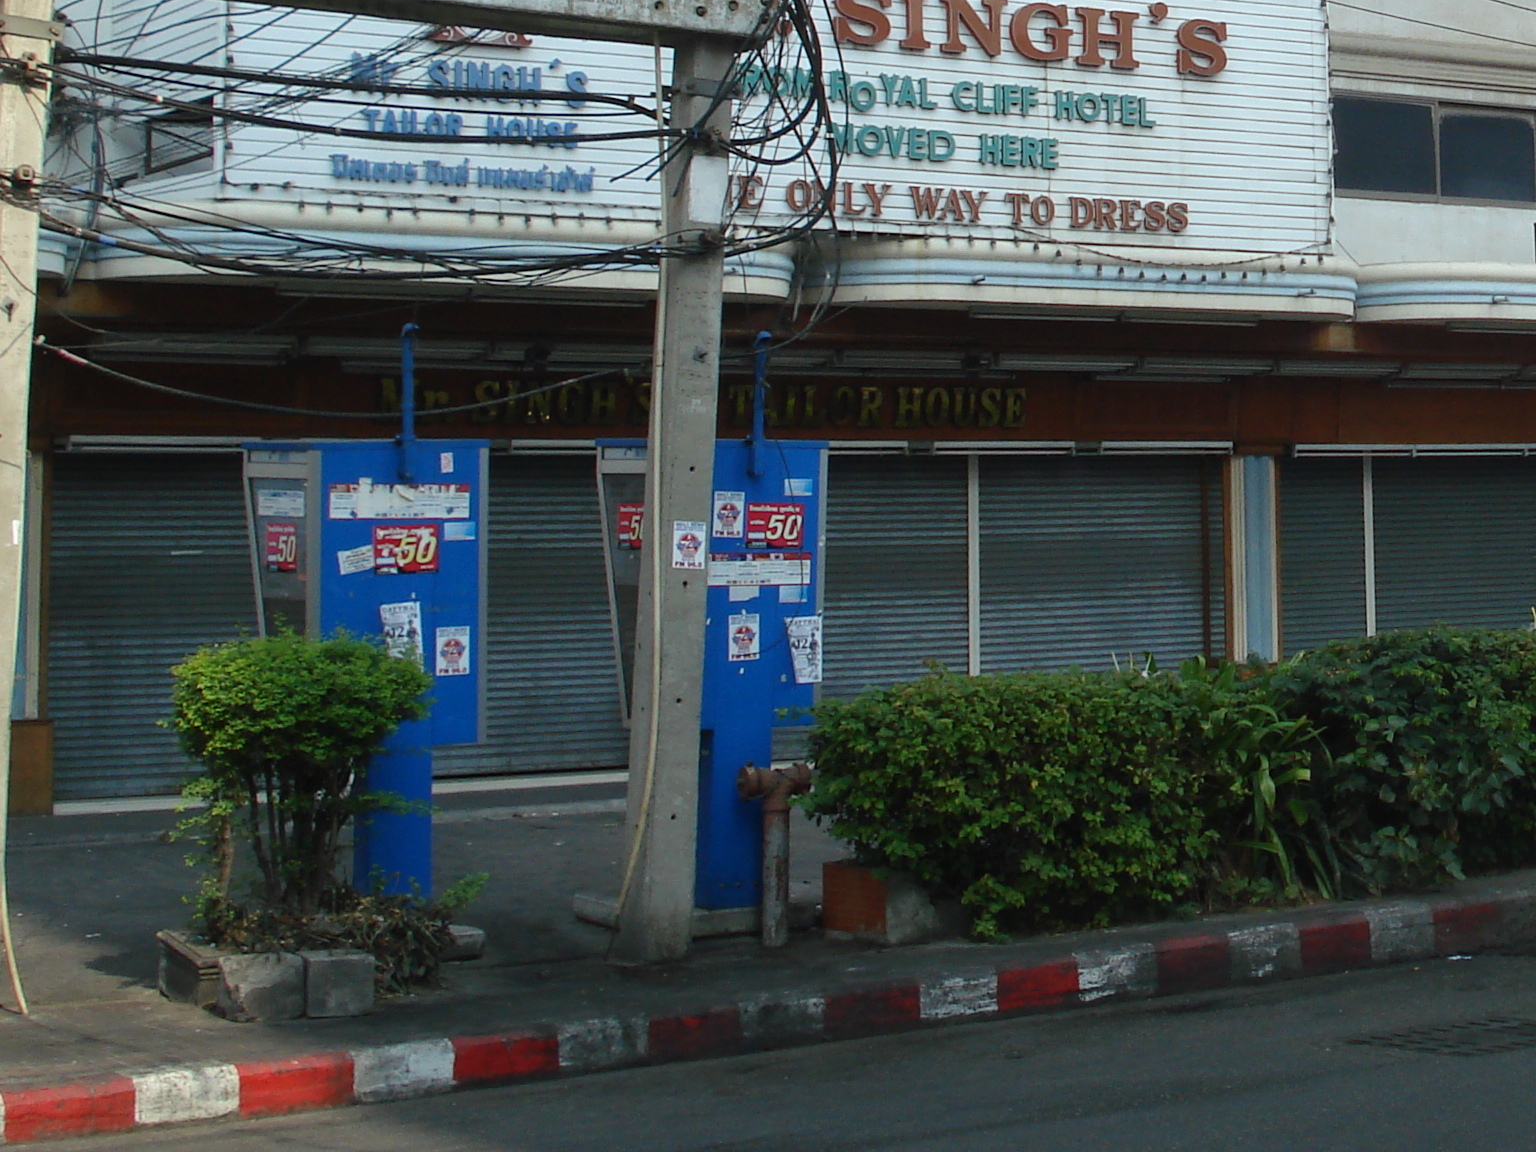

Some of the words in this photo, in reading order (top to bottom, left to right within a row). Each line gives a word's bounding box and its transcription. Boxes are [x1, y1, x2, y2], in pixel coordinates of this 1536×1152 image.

[829, 69, 939, 112] ROYAL
[951, 80, 1039, 116] CLIFF
[1054, 89, 1157, 128] HOTEL
[363, 108, 463, 143] TAILOR
[486, 113, 579, 149] HOUSE
[828, 122, 956, 162] MOVED
[979, 133, 1060, 169] HERE
[786, 179, 892, 216] ONLY
[909, 185, 989, 222] WAY
[1005, 192, 1055, 226] TO
[1069, 196, 1189, 232] DRESS
[379, 378, 450, 426] Mr.
[897, 385, 1027, 429] HOUSE
[278, 535, 296, 563] 50
[766, 514, 803, 540] 50
